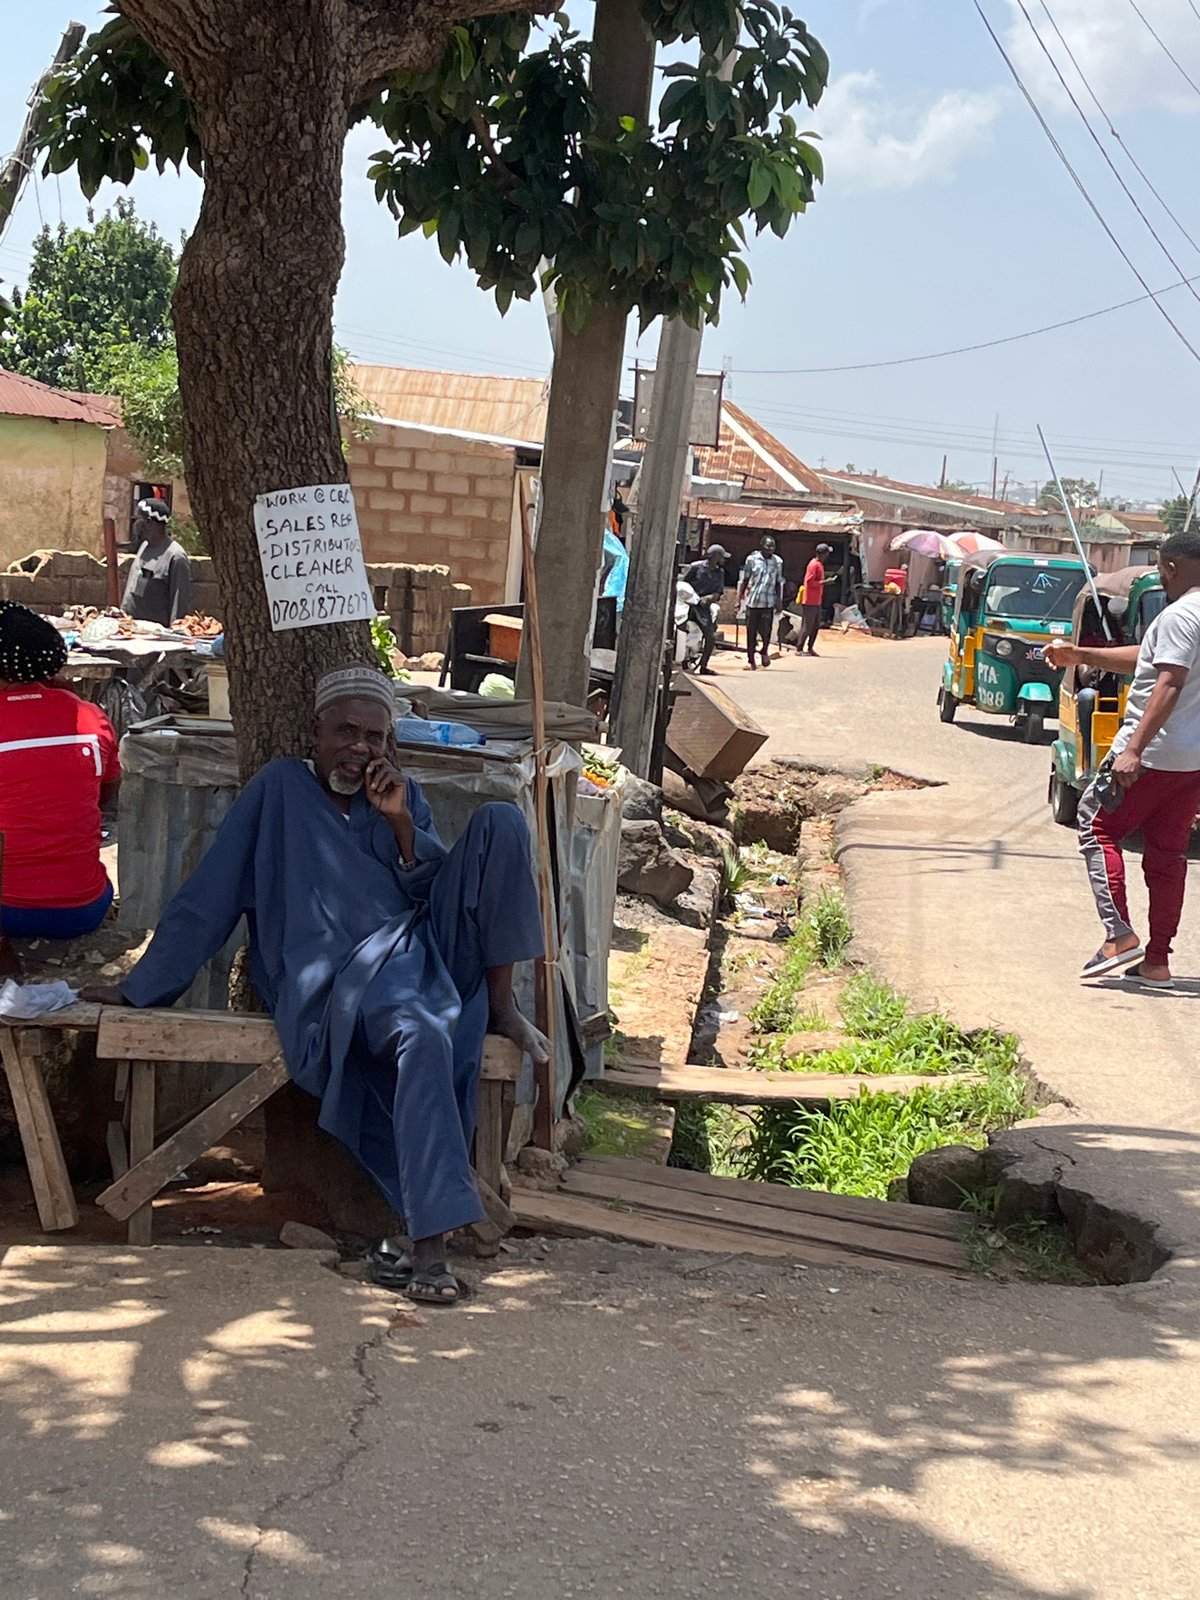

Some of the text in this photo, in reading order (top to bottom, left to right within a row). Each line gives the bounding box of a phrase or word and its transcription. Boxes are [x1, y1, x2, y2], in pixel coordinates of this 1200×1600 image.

[266, 492, 307, 508] WORK
[314, 487, 325, 503] @
[265, 515, 325, 539] SALES
[270, 556, 354, 580] CLEANER
[305, 582, 339, 594] CALL
